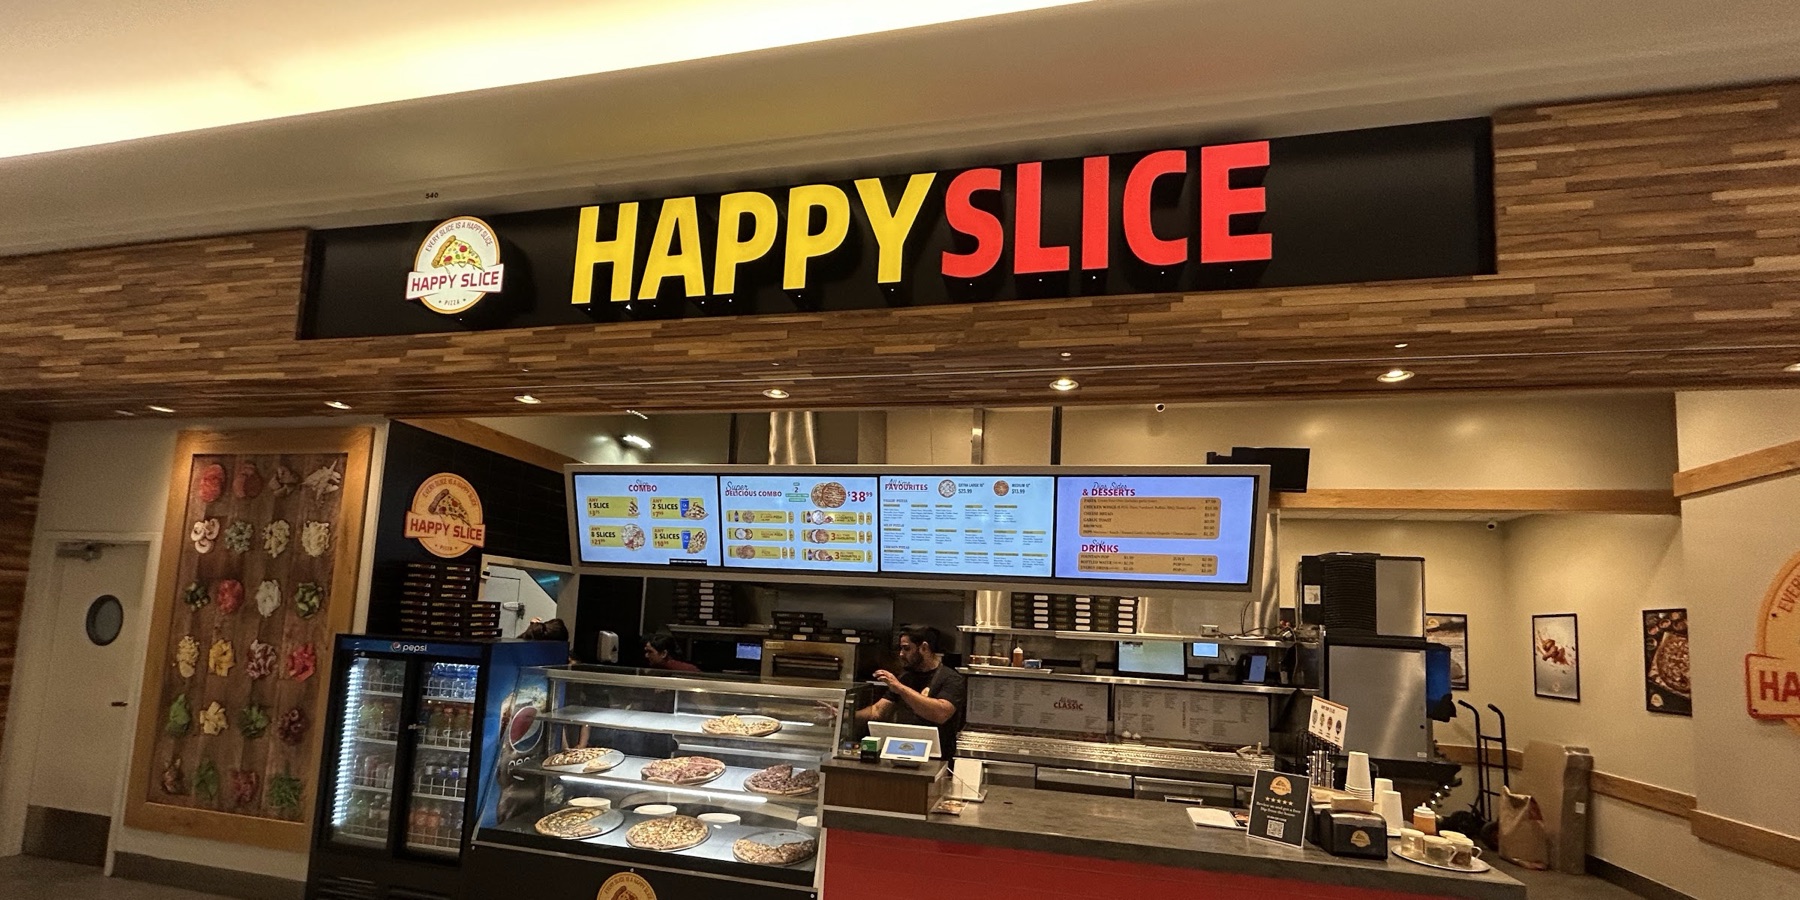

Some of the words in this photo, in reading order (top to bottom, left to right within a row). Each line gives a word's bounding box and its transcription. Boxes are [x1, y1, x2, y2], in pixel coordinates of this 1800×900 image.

[425, 235, 440, 252] EVERY
[438, 223, 455, 237] SLICE
[455, 222, 462, 230] IS
[466, 222, 483, 233] HAPPY
[480, 230, 494, 246] SLICE
[411, 274, 457, 292] HAPPY
[460, 271, 500, 288] SLICE
[726, 480, 749, 490] Super
[1092, 488, 1136, 496] DESSERTS
[410, 518, 450, 536] HAPPY
[452, 525, 482, 541] SLICE
[1777, 574, 1800, 613] EVER
[402, 644, 427, 652] pepsi
[1053, 702, 1083, 710] CLASSIC
